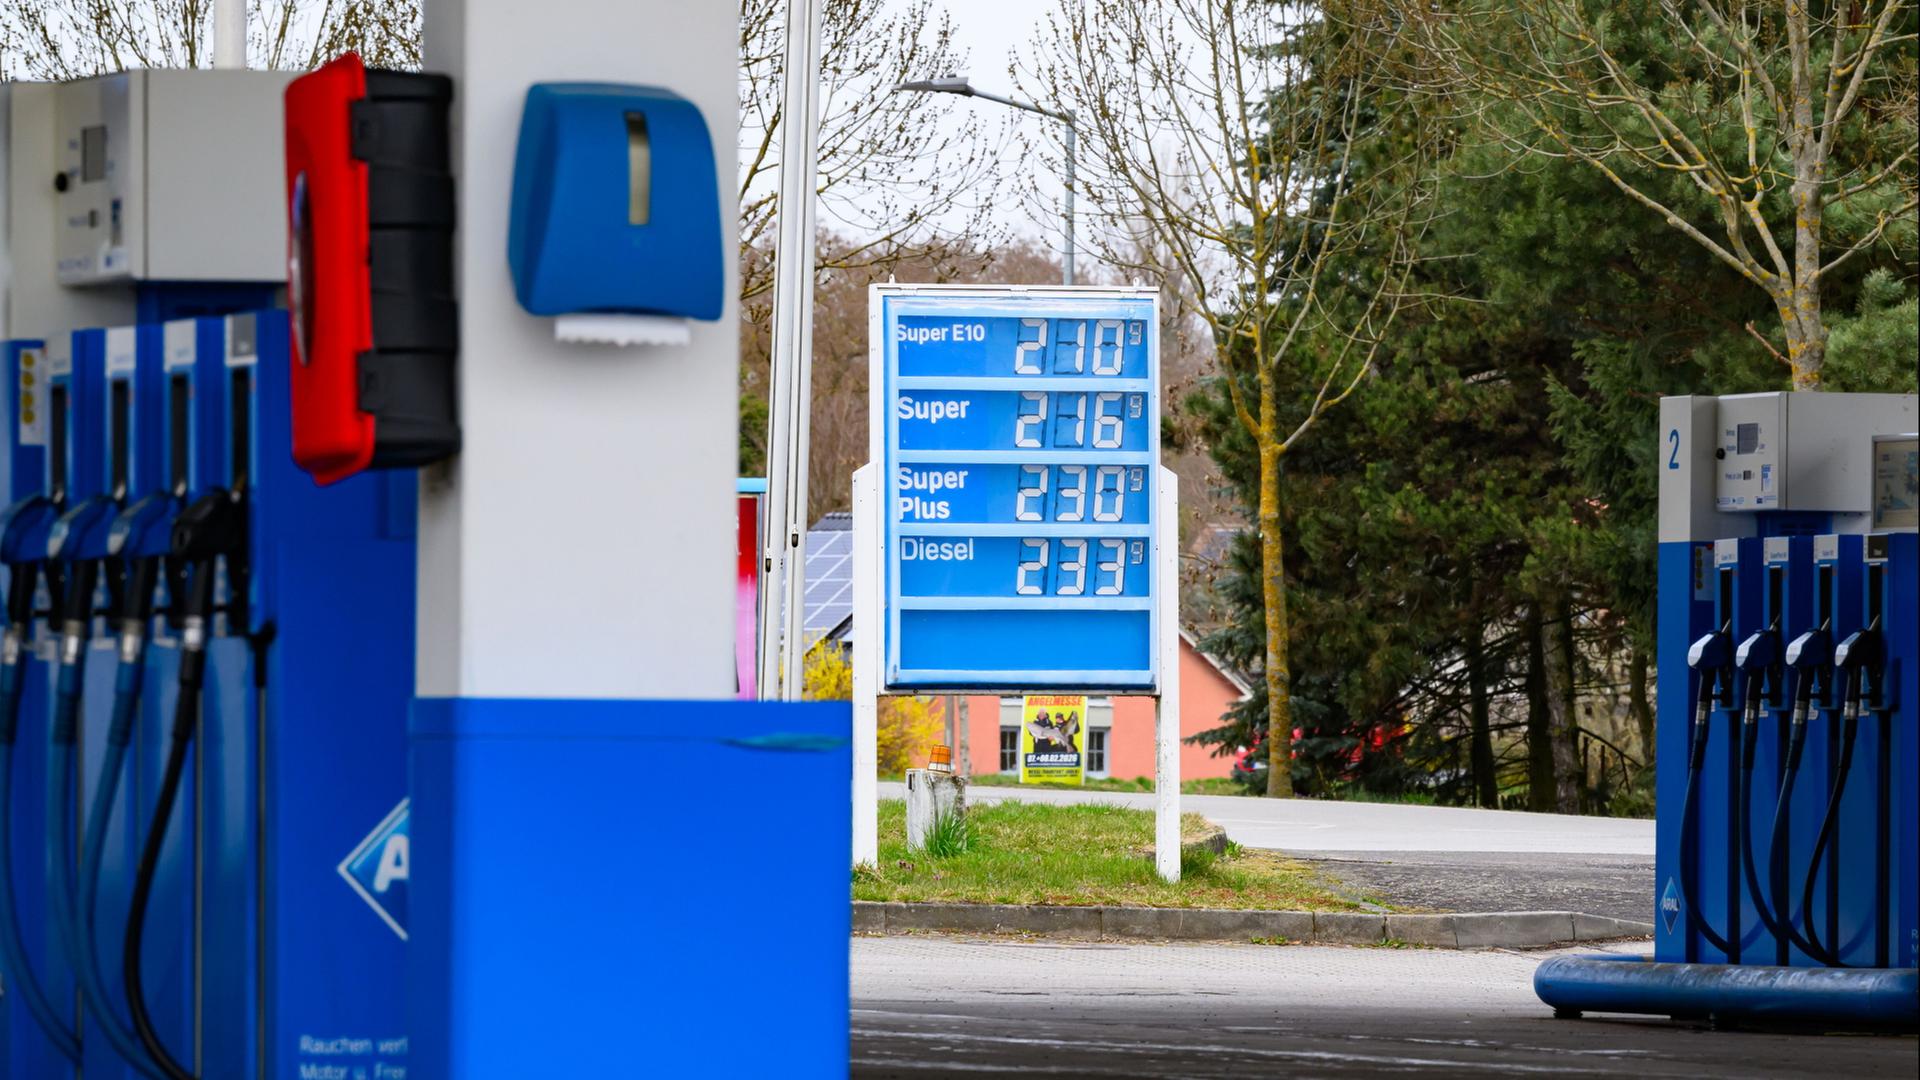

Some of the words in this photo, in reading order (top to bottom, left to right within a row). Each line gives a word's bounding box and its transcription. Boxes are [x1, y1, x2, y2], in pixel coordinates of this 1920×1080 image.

[897, 324, 948, 344] Super
[952, 324, 985, 341] E10
[898, 397, 970, 423] Super
[1668, 429, 1680, 470] 2
[898, 466, 968, 493] Super
[898, 496, 950, 520] Plus
[900, 537, 974, 560] Diesel
